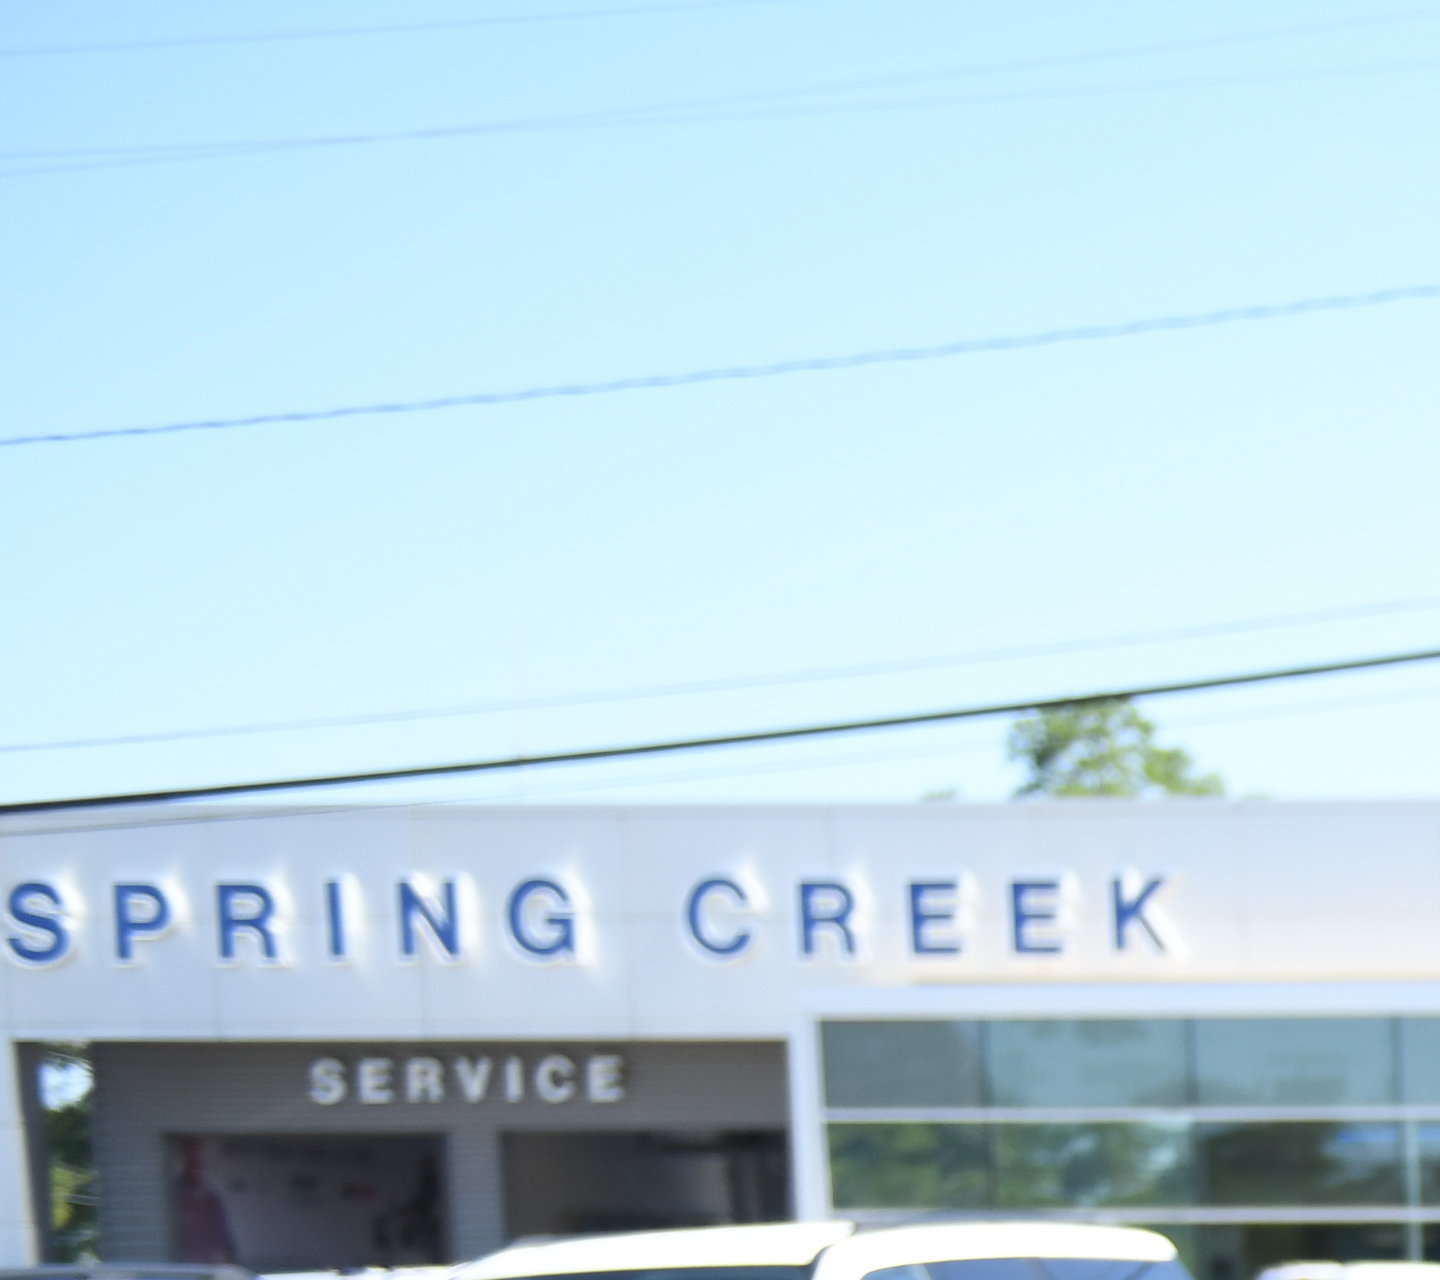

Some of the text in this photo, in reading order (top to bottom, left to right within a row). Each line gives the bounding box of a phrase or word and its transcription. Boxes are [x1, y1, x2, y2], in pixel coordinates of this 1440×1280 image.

[5, 876, 1168, 963] SPRING CREEK
[309, 1054, 626, 1104] SERVICE
